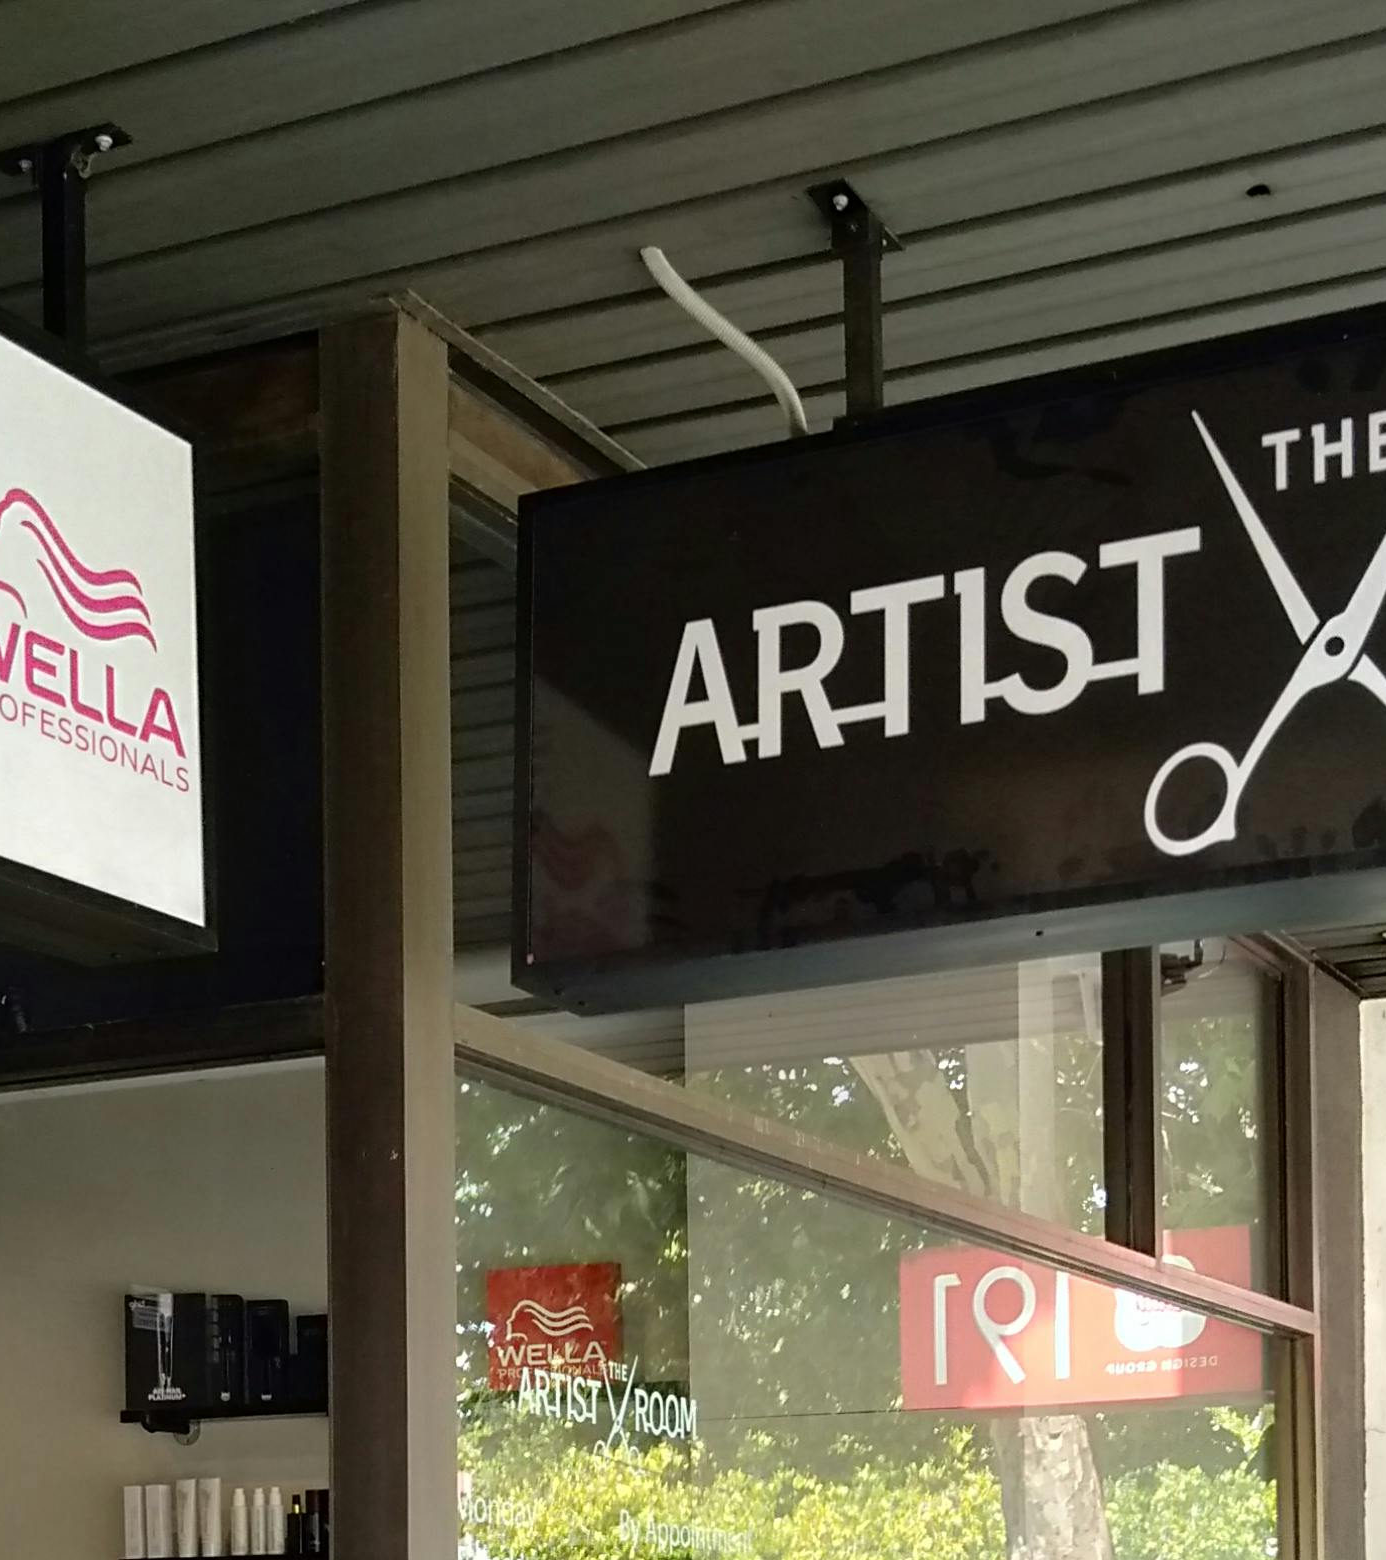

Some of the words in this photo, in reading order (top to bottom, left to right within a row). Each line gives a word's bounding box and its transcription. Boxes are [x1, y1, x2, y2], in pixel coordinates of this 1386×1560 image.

[649, 526, 1201, 777] ARTIST
[496, 1341, 607, 1367] WELLA
[609, 1361, 629, 1382] THE
[517, 1366, 602, 1425] ARTIST
[634, 1387, 698, 1441] ROOM
